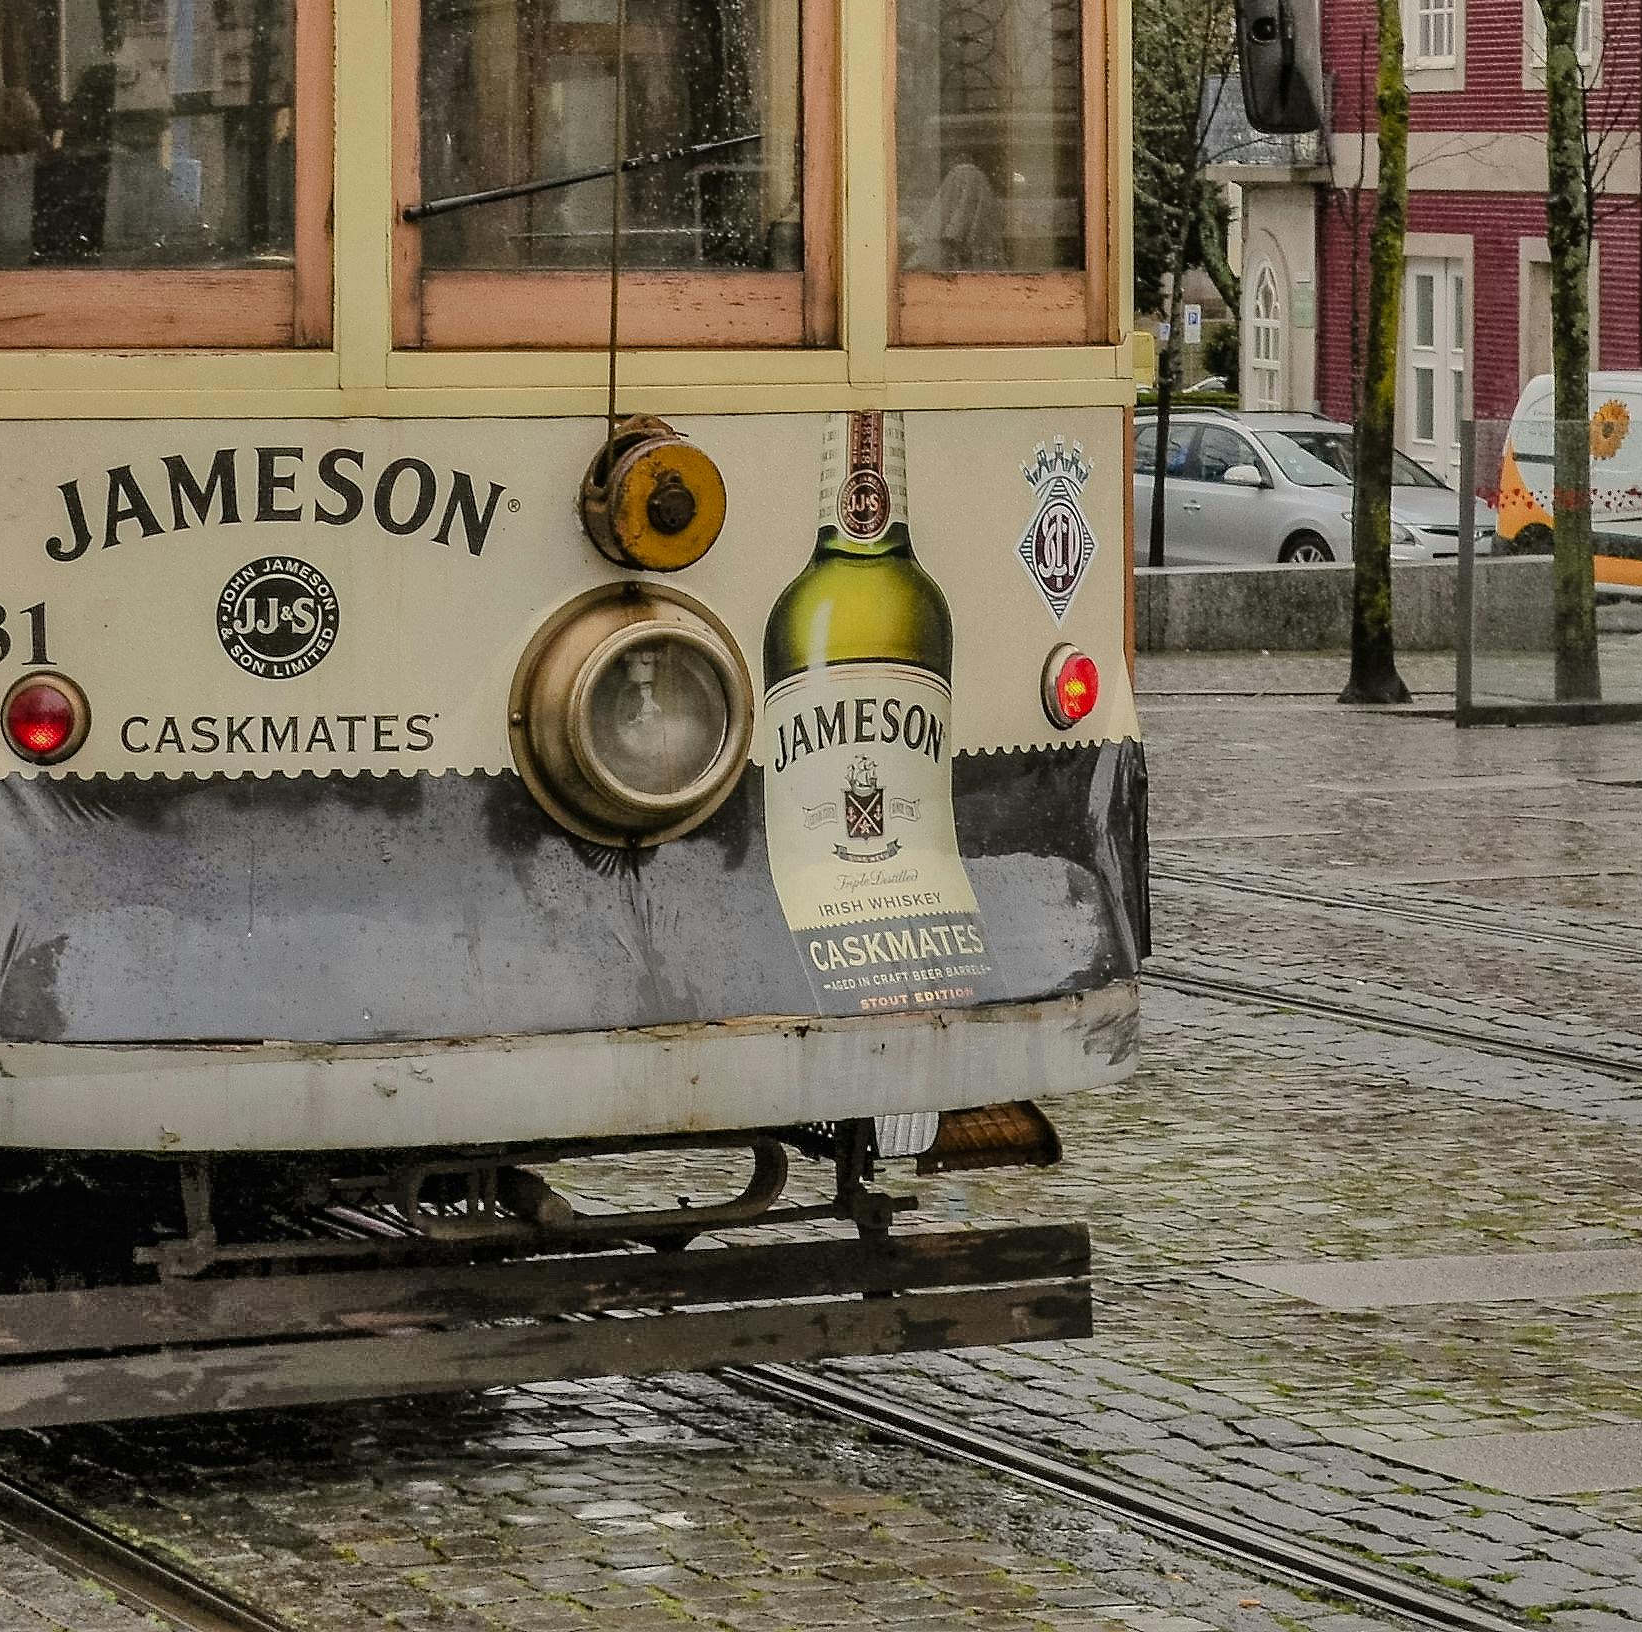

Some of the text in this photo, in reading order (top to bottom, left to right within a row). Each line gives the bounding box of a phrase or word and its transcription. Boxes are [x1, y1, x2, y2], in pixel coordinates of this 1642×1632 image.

[220, 558, 337, 613] JOHN JAMESON
[233, 596, 316, 635] JJ&S
[230, 644, 266, 675] SON
[273, 627, 335, 677] LIMITED
[120, 713, 436, 755] CASKMATES
[775, 697, 944, 774] JAMESON
[818, 891, 942, 918] IRISH WHISKEY
[809, 923, 985, 973] CASKMATES
[858, 976, 871, 988] IN
[873, 970, 909, 986] CRAFT
[913, 967, 944, 981] BEER
[860, 987, 974, 1010] STOUT EDITION
